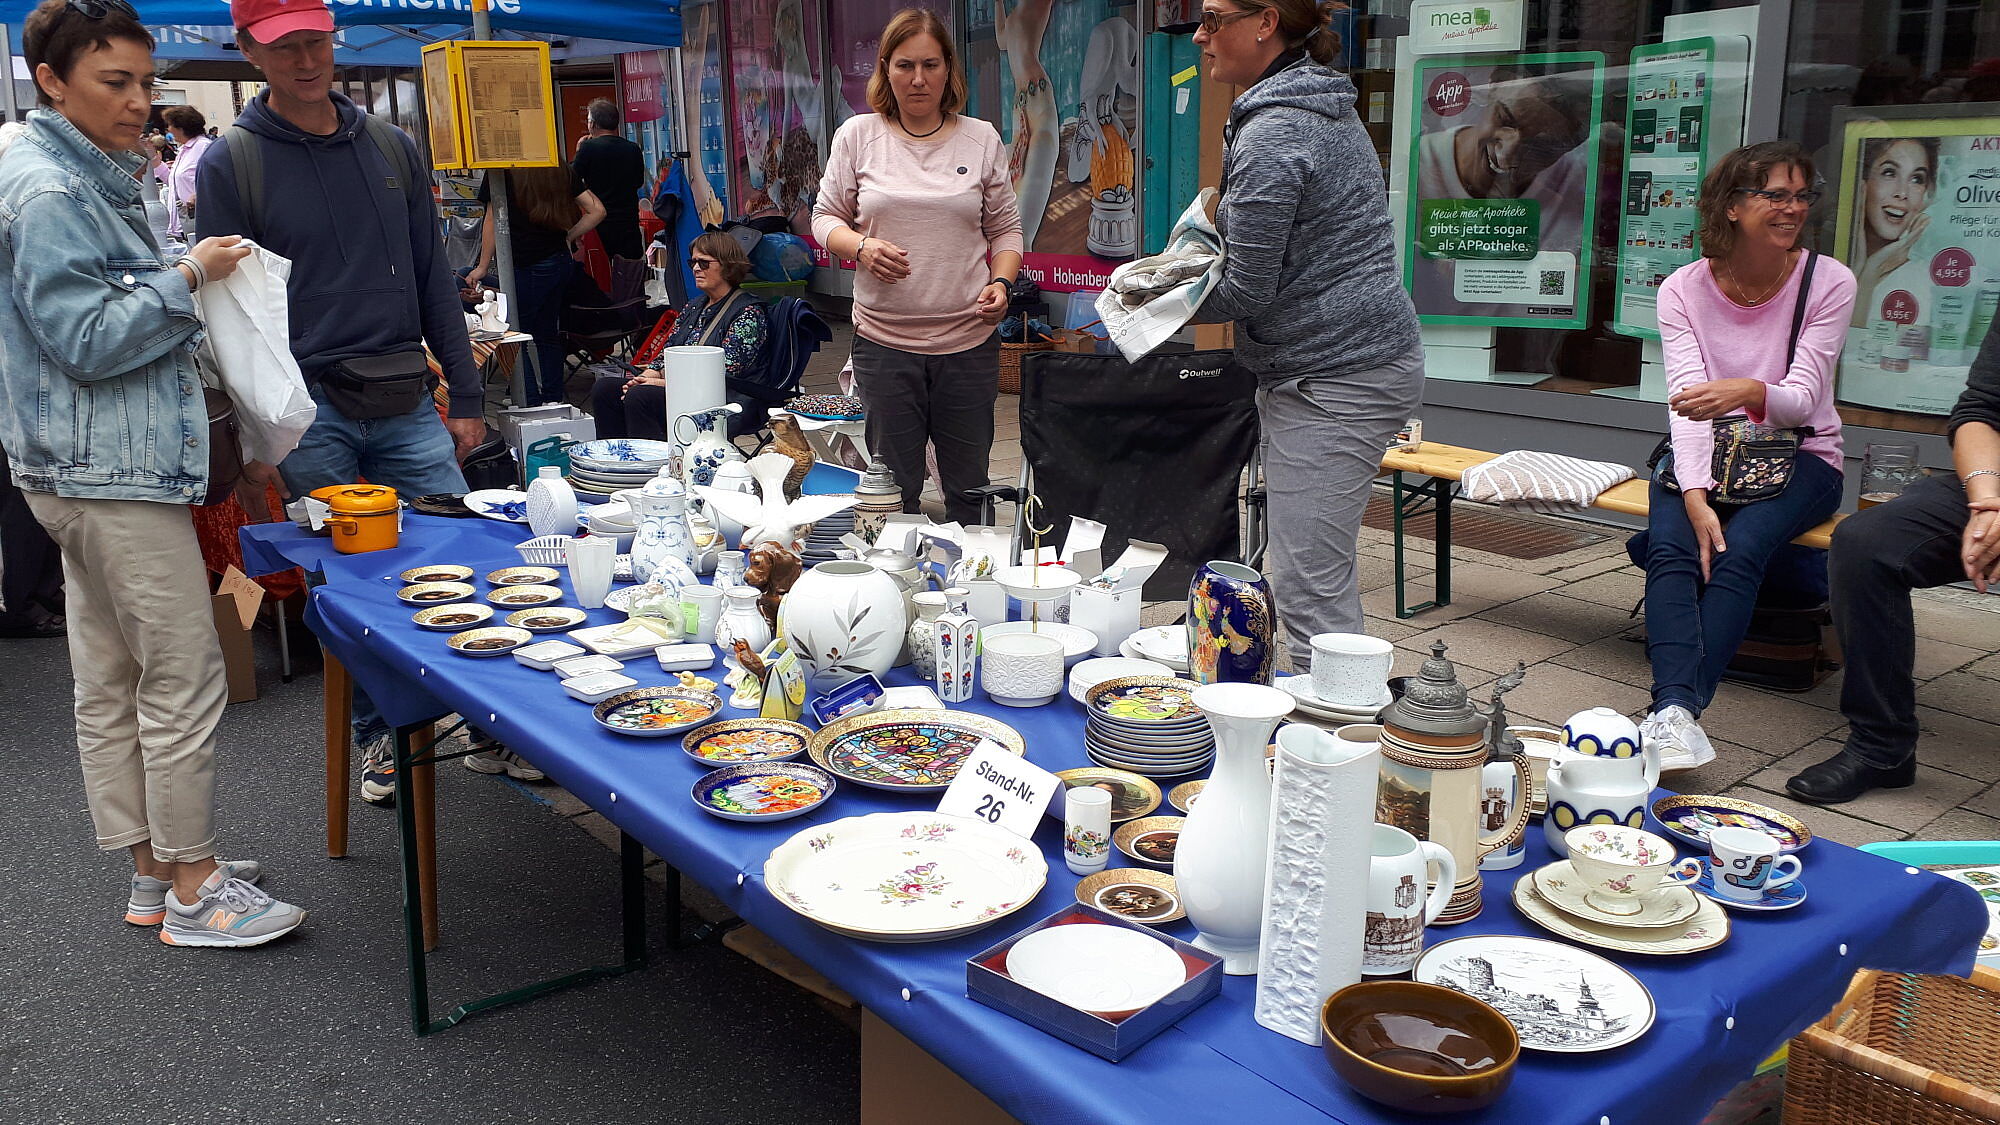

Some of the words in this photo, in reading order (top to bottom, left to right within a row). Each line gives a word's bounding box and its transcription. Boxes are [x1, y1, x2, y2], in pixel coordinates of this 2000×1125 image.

[1431, 11, 1472, 26] mea
[1436, 83, 1463, 104] App
[1430, 208, 1458, 220] Meine
[1483, 205, 1527, 220] Apotheke
[1950, 215, 1980, 227] Pflege
[1429, 222, 1459, 237] gibts
[1461, 222, 1490, 237] jetzt
[1493, 225, 1528, 237] sogar
[1963, 228, 1983, 238] und
[1438, 239, 1454, 251] als
[1457, 240, 1529, 251] APPotheke.
[1946, 258, 1958, 267] Je
[1894, 300, 1905, 309] Je
[1190, 368, 1221, 377] Outwell
[975, 761, 1035, 804] Stand-Nr.
[974, 794, 1005, 824] 26
